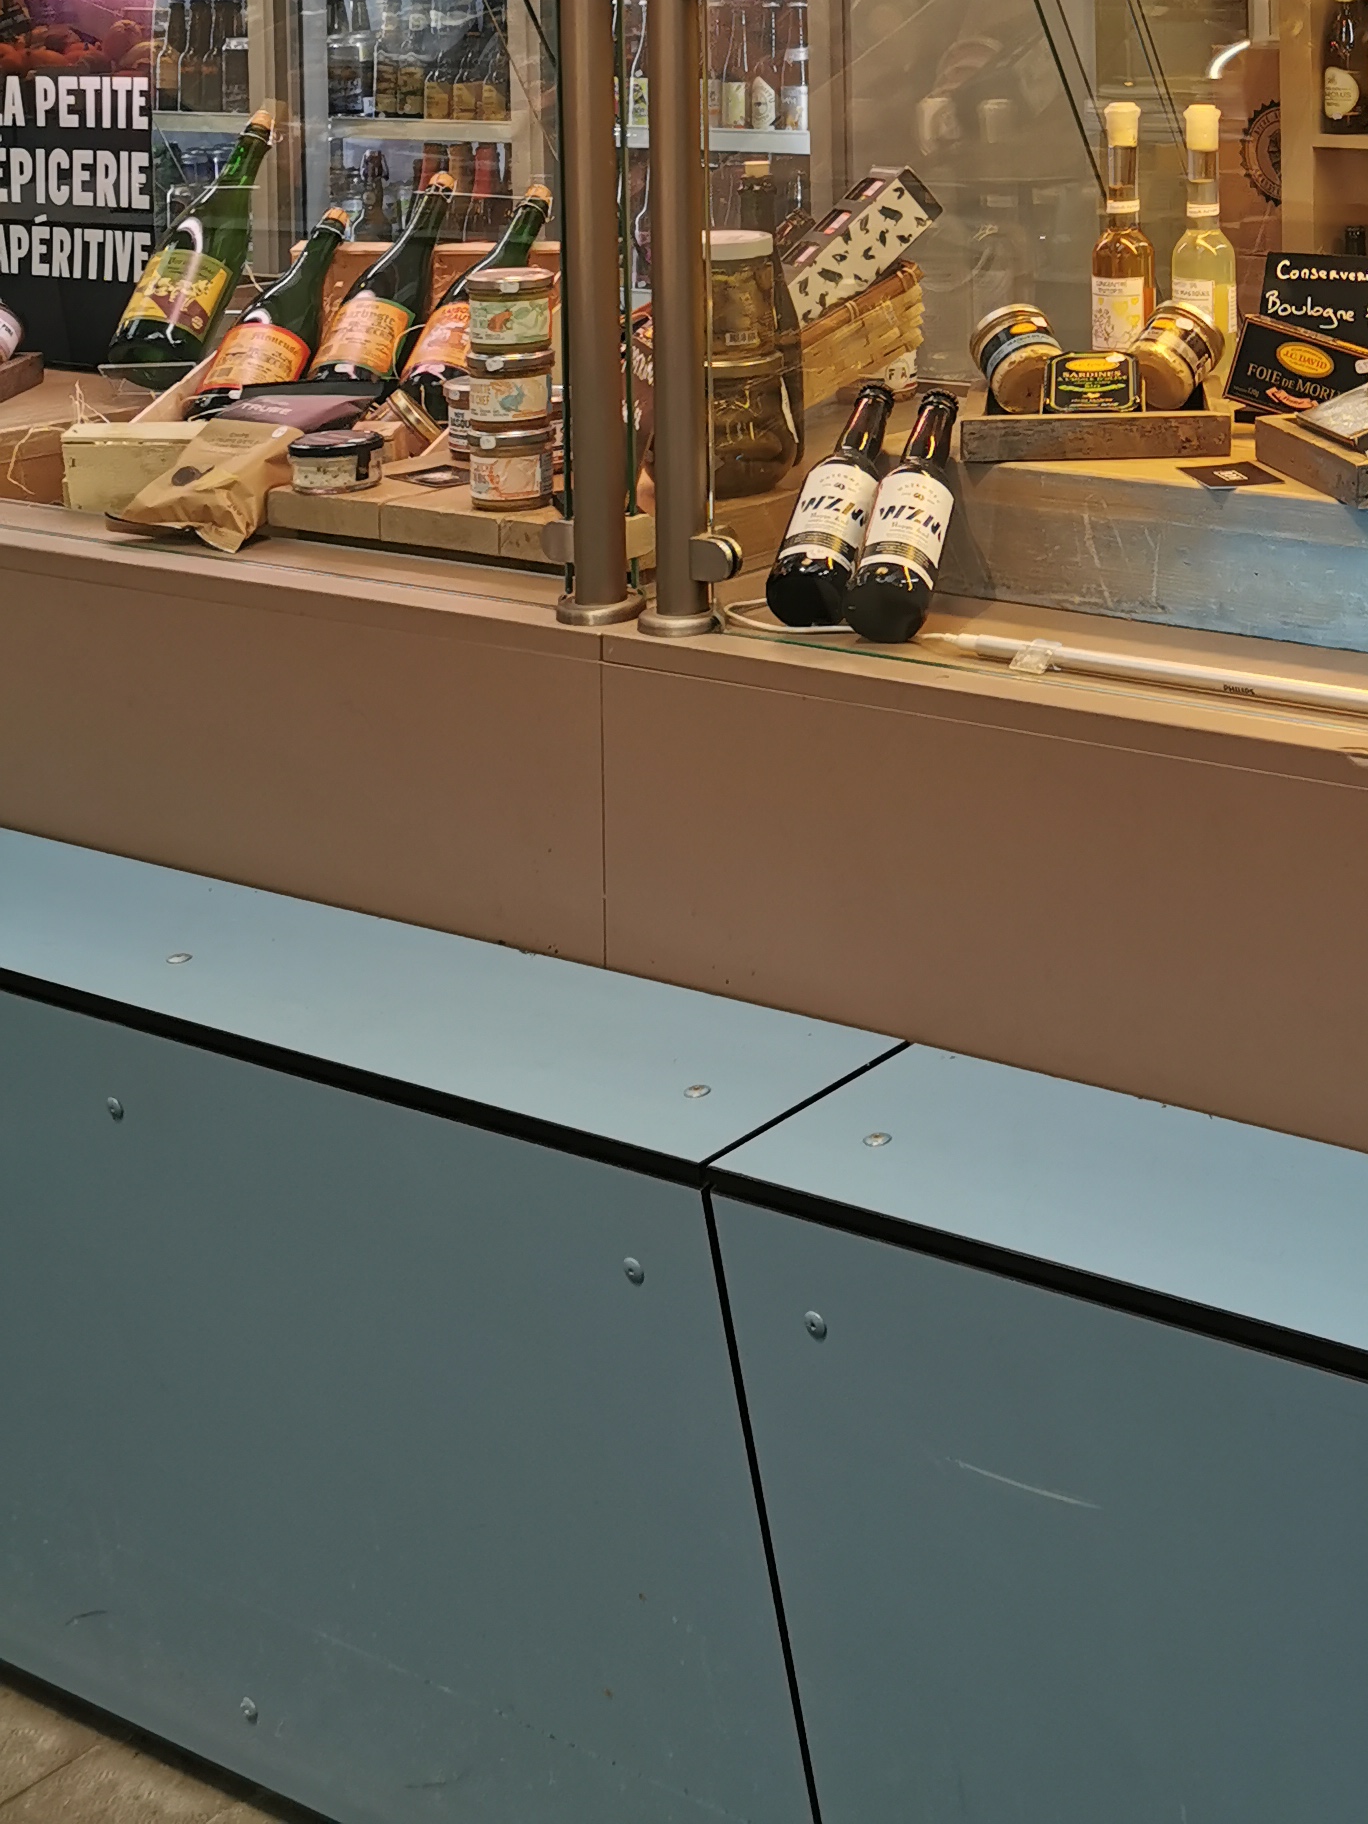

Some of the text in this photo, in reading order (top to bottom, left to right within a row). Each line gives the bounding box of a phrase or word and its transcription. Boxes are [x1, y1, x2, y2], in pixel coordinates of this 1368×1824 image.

[0, 76, 149, 130] A PETITE
[1265, 289, 1355, 330] Boulogne
[1247, 363, 1342, 401] FOIE DE MORU
